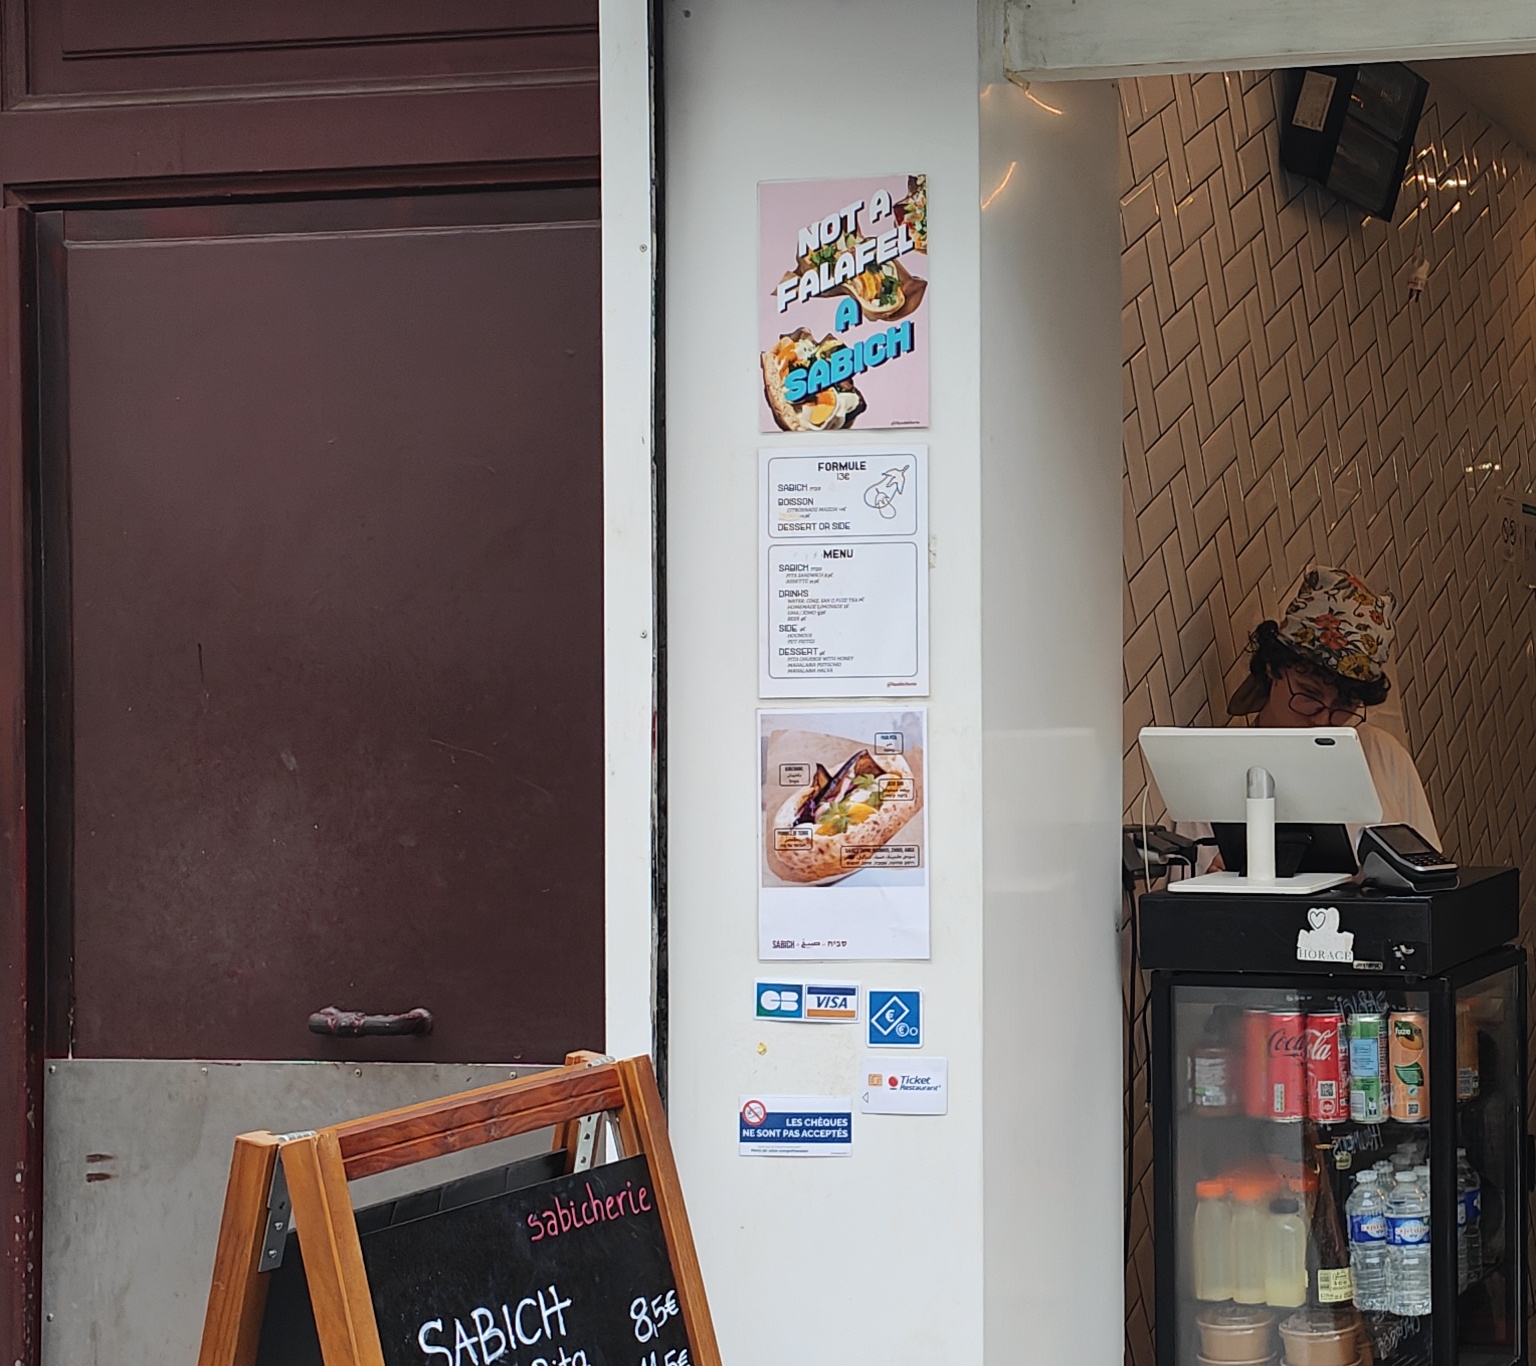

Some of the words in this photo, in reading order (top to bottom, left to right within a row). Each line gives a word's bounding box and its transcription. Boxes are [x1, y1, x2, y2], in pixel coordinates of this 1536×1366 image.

[799, 201, 864, 257] NOT
[870, 189, 893, 223] A
[778, 224, 914, 313] FALAFEL
[836, 298, 862, 332] A
[784, 321, 914, 403] SABICH
[818, 461, 866, 471] FORMULE
[778, 484, 807, 492] SABICH
[778, 498, 813, 506] BOISSON
[778, 523, 817, 531] DESSERT
[832, 522, 851, 530] SIDE
[823, 549, 854, 558] MENU
[779, 564, 809, 572] SABICH
[779, 590, 809, 598] DRINKS
[773, 940, 795, 949] SABICH
[760, 990, 799, 1011] CB
[816, 996, 848, 1009] VISA
[901, 1076, 931, 1084] Ticket
[786, 1118, 802, 1127] LES
[804, 1117, 848, 1126] CHÈQUES
[743, 1129, 755, 1137] NE
[757, 1129, 781, 1137] SONT
[783, 1130, 800, 1138] PAS
[801, 1128, 848, 1138] ACCEPTÉS
[527, 1182, 652, 1242] sabicherie
[630, 1290, 680, 1343] 8,5€
